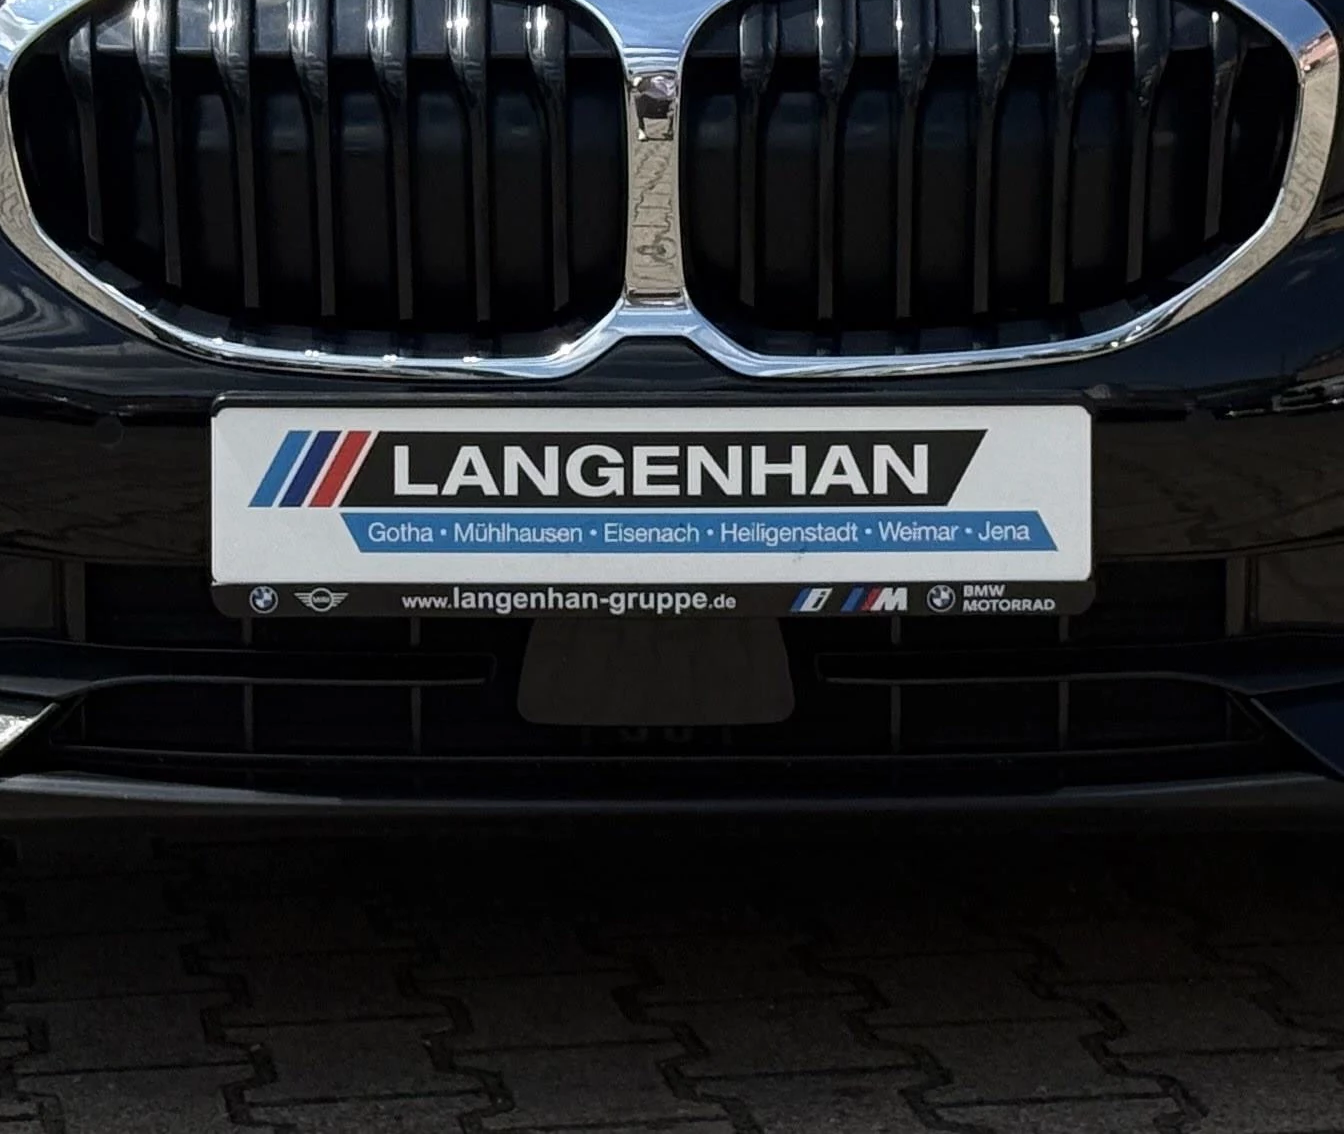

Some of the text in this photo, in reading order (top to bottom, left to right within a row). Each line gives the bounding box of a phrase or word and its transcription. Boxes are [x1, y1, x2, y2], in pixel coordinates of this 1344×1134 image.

[393, 444, 929, 497] LANGENHAN
[367, 520, 1030, 547] Gotha Mühlhausen Eisenach Heiligenstadt Weimar Jena
[401, 586, 737, 614] www.langenhan-gruppe.de
[963, 584, 1006, 597] BMW
[962, 598, 1056, 612] MOTORRAD
